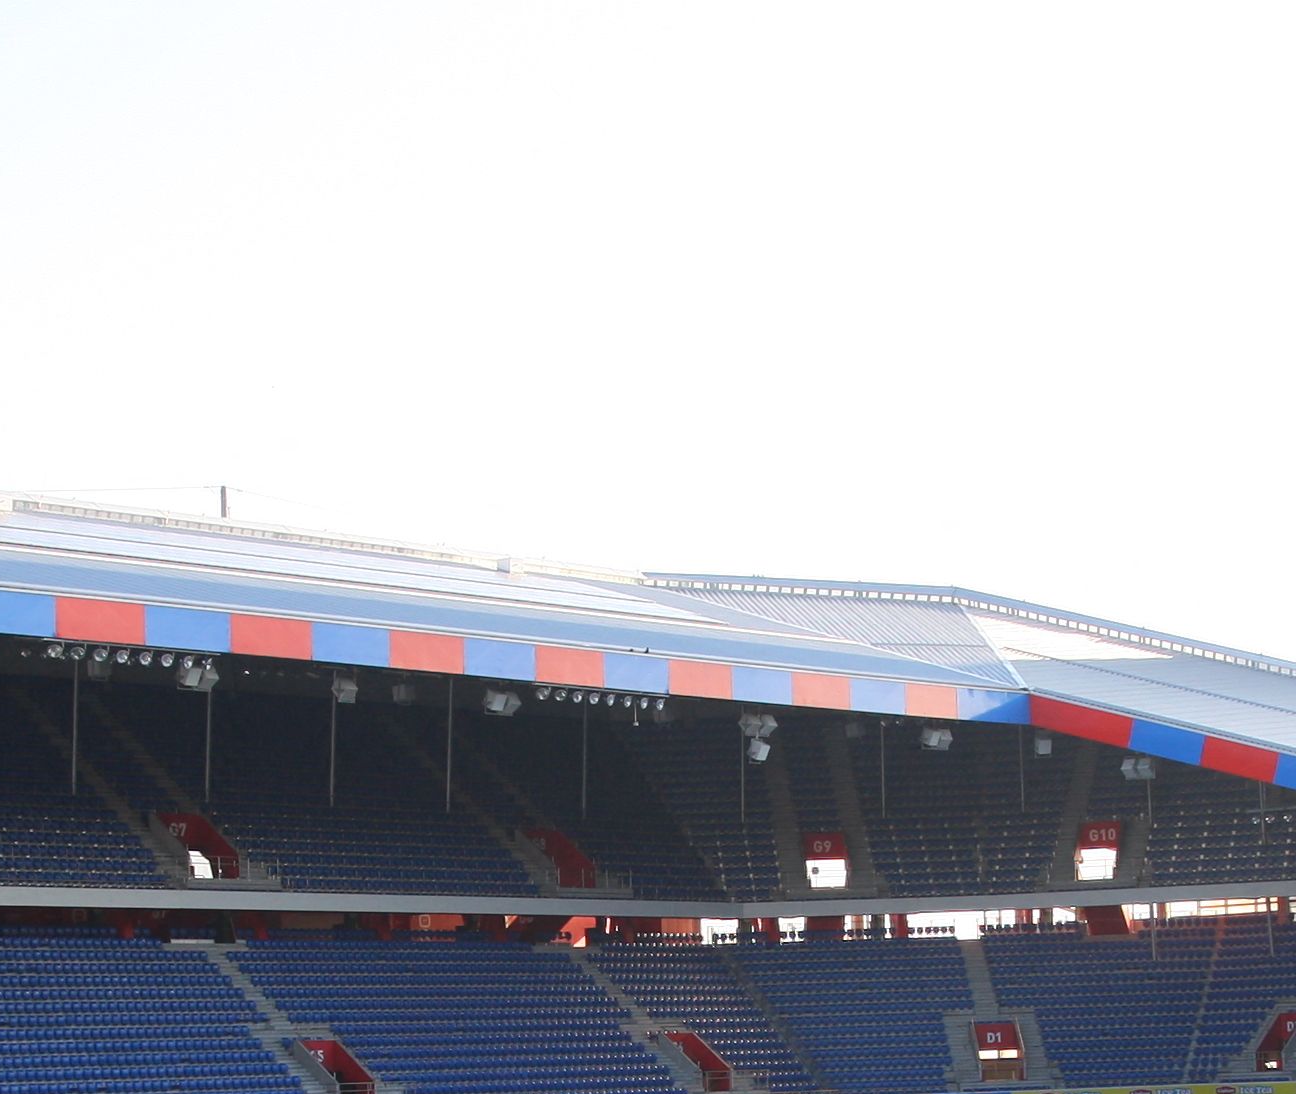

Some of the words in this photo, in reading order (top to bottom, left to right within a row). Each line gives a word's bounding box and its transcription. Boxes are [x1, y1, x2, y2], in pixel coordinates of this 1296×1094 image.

[169, 822, 187, 837] G7
[1090, 829, 1116, 842] G10
[813, 840, 832, 853] G9
[987, 1032, 1001, 1043] D1
[1256, 1086, 1273, 1094] Tea
